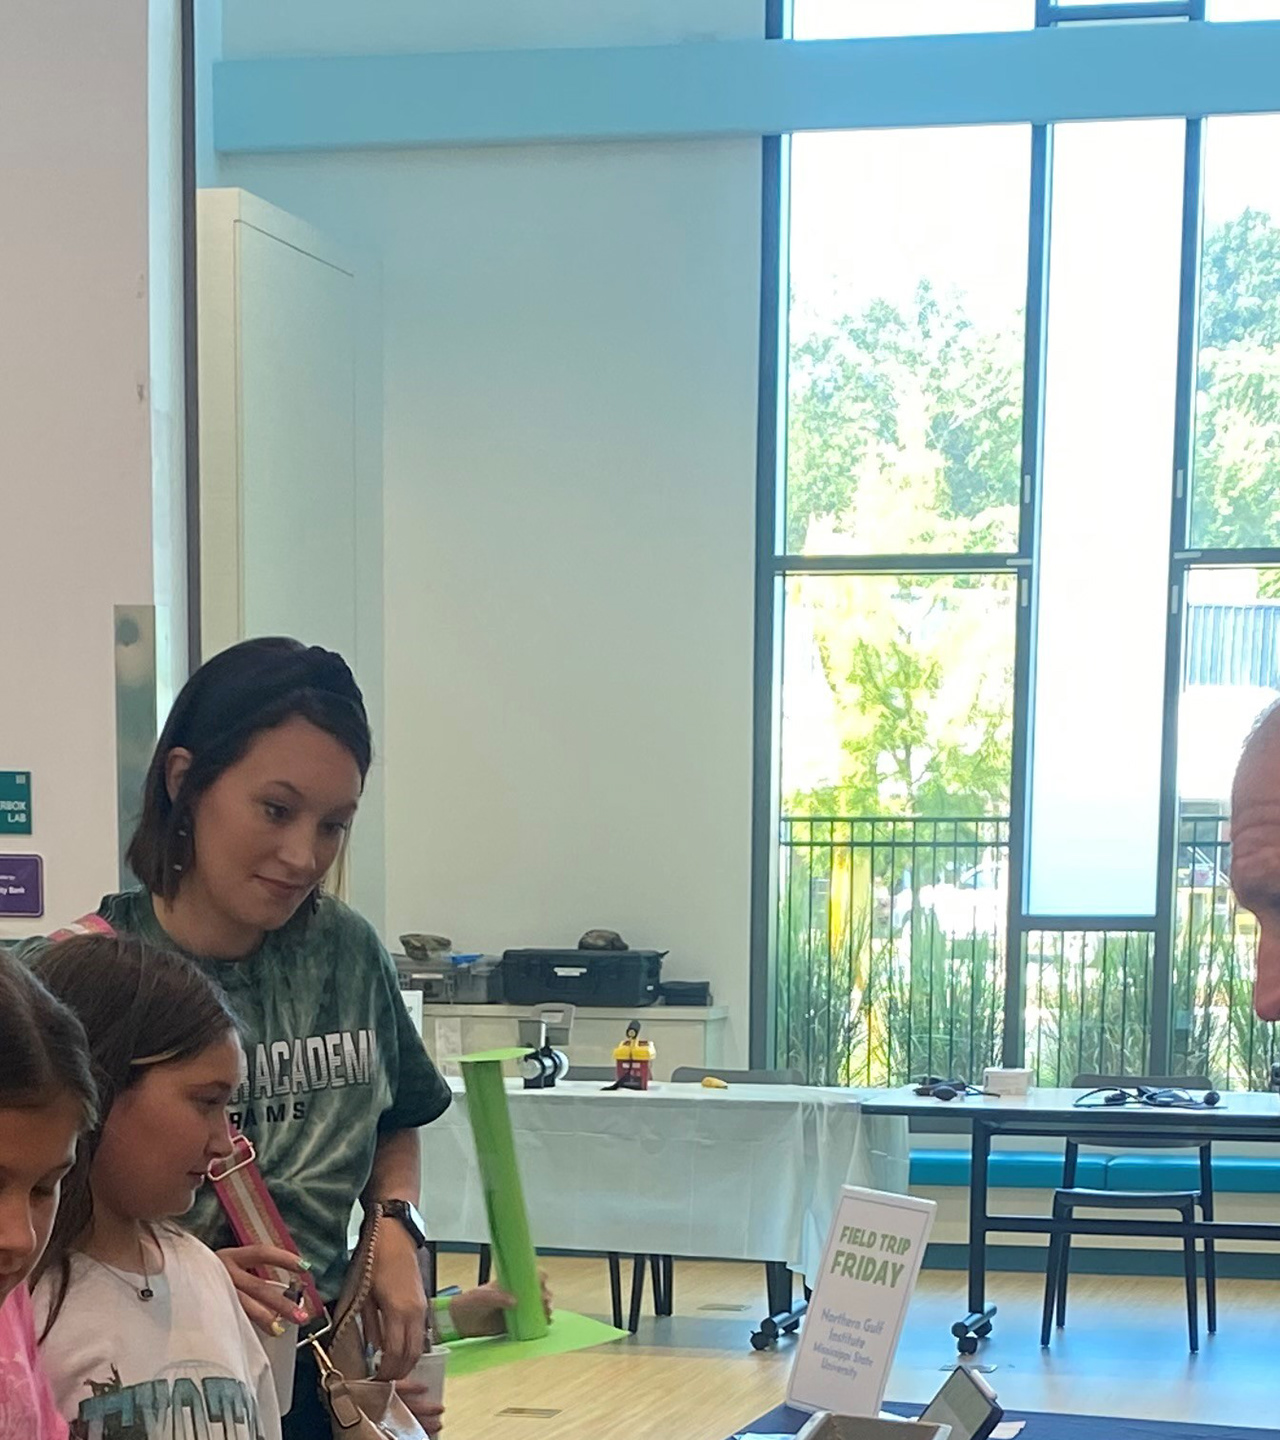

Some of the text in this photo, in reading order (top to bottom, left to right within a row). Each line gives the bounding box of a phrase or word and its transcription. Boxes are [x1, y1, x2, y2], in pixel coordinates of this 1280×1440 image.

[7, 813, 26, 822] LAB
[9, 886, 25, 894] Bank
[229, 1101, 306, 1130] RAMS
[839, 1225, 911, 1255] FIELD TRIP
[830, 1250, 904, 1288] FRIDAY
[821, 1308, 885, 1335] Northern Gulf
[828, 1327, 866, 1349] Institute
